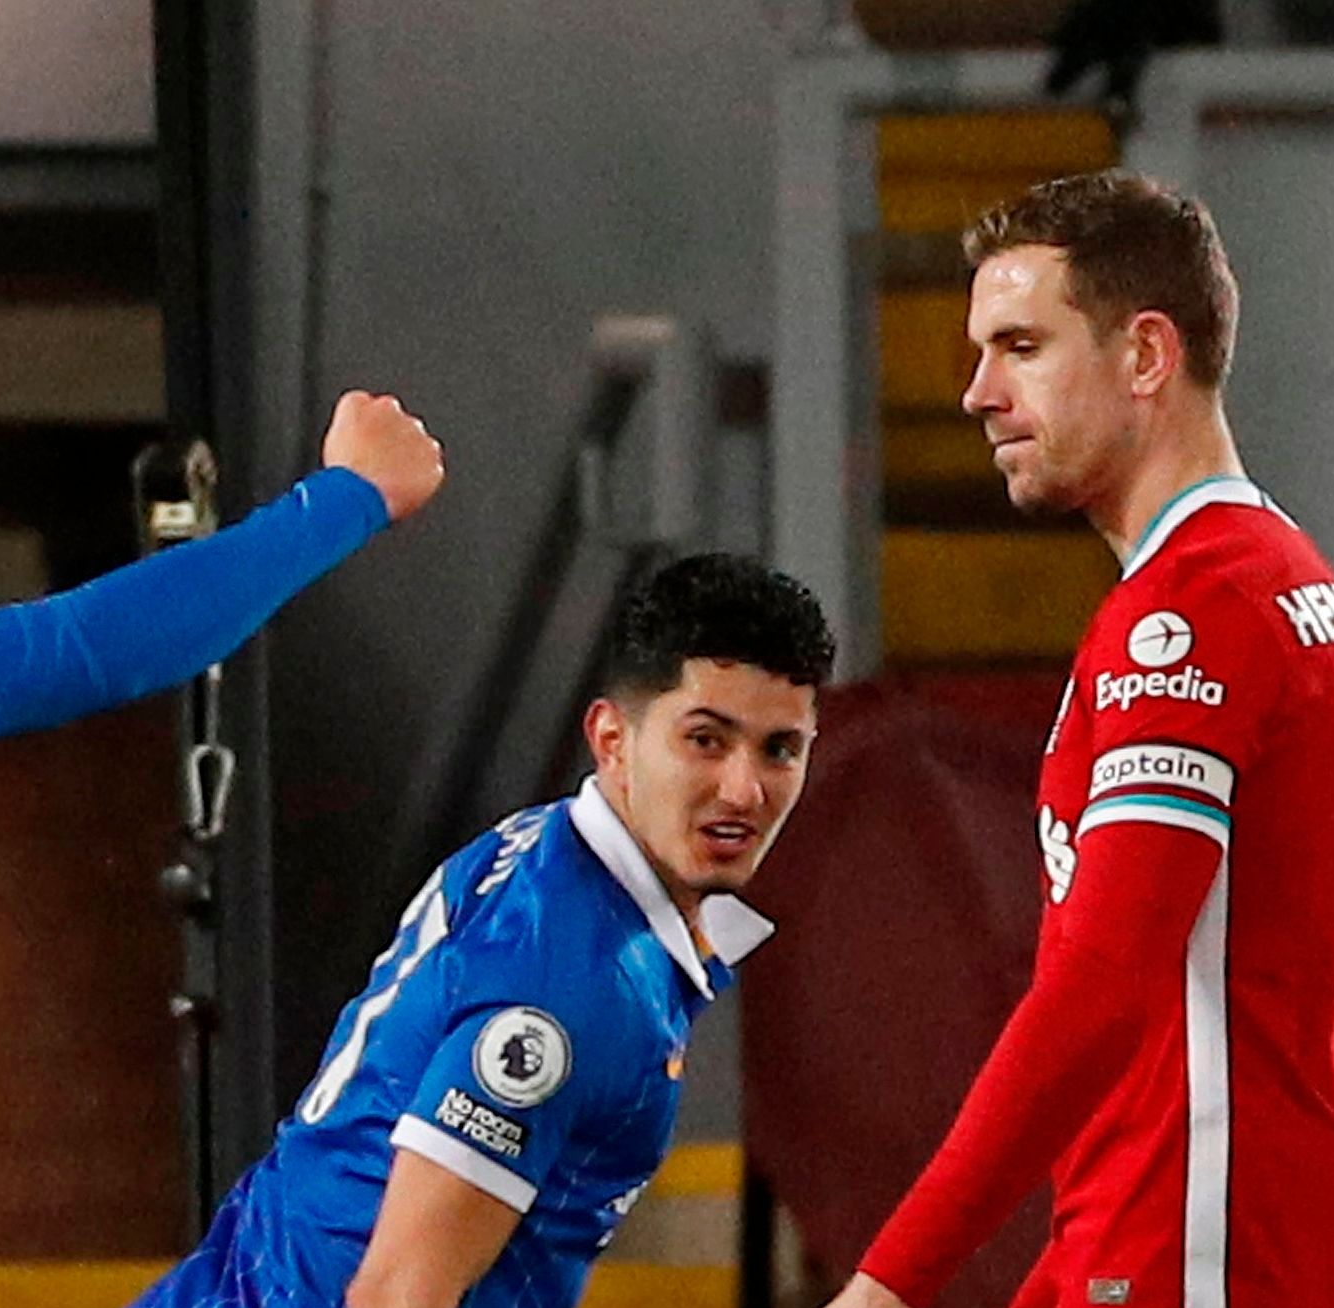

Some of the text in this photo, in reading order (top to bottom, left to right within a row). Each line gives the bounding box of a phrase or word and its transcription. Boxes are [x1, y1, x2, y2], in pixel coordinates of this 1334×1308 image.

[1095, 665, 1224, 711] Expedia
[439, 1086, 524, 1142] No room
[461, 1119, 523, 1160] racism
